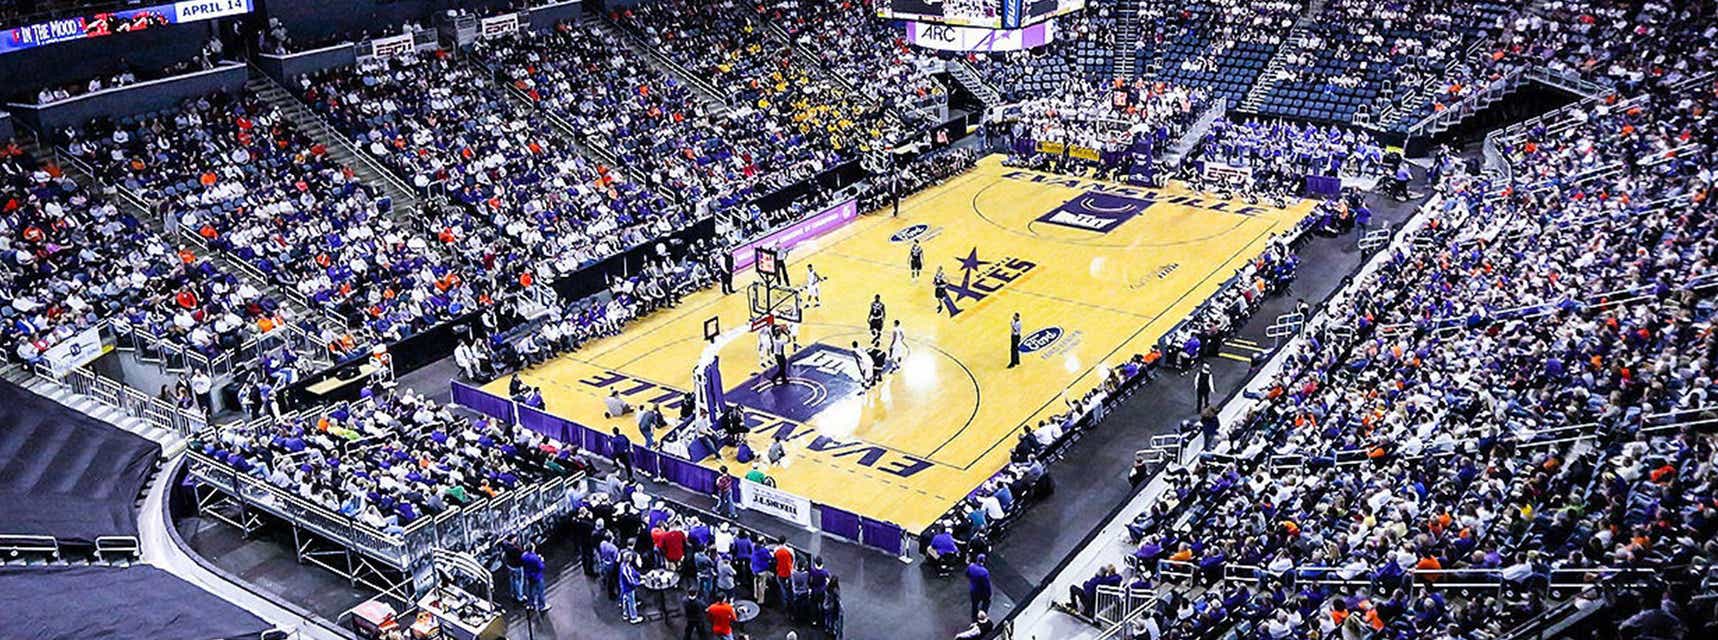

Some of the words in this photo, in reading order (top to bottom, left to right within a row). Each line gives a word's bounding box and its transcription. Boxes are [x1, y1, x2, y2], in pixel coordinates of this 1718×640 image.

[182, 2, 223, 17] APRIL
[227, 0, 243, 9] 14
[20, 26, 33, 43] IN
[31, 24, 50, 45] THE
[49, 19, 77, 37] MOOD
[485, 18, 517, 34] ESPN
[921, 25, 957, 42] ARC
[376, 39, 412, 57] ESPN
[1001, 171, 1270, 216] EVANSVILLE
[944, 250, 1037, 318] ACES
[1025, 330, 1057, 350] Ford
